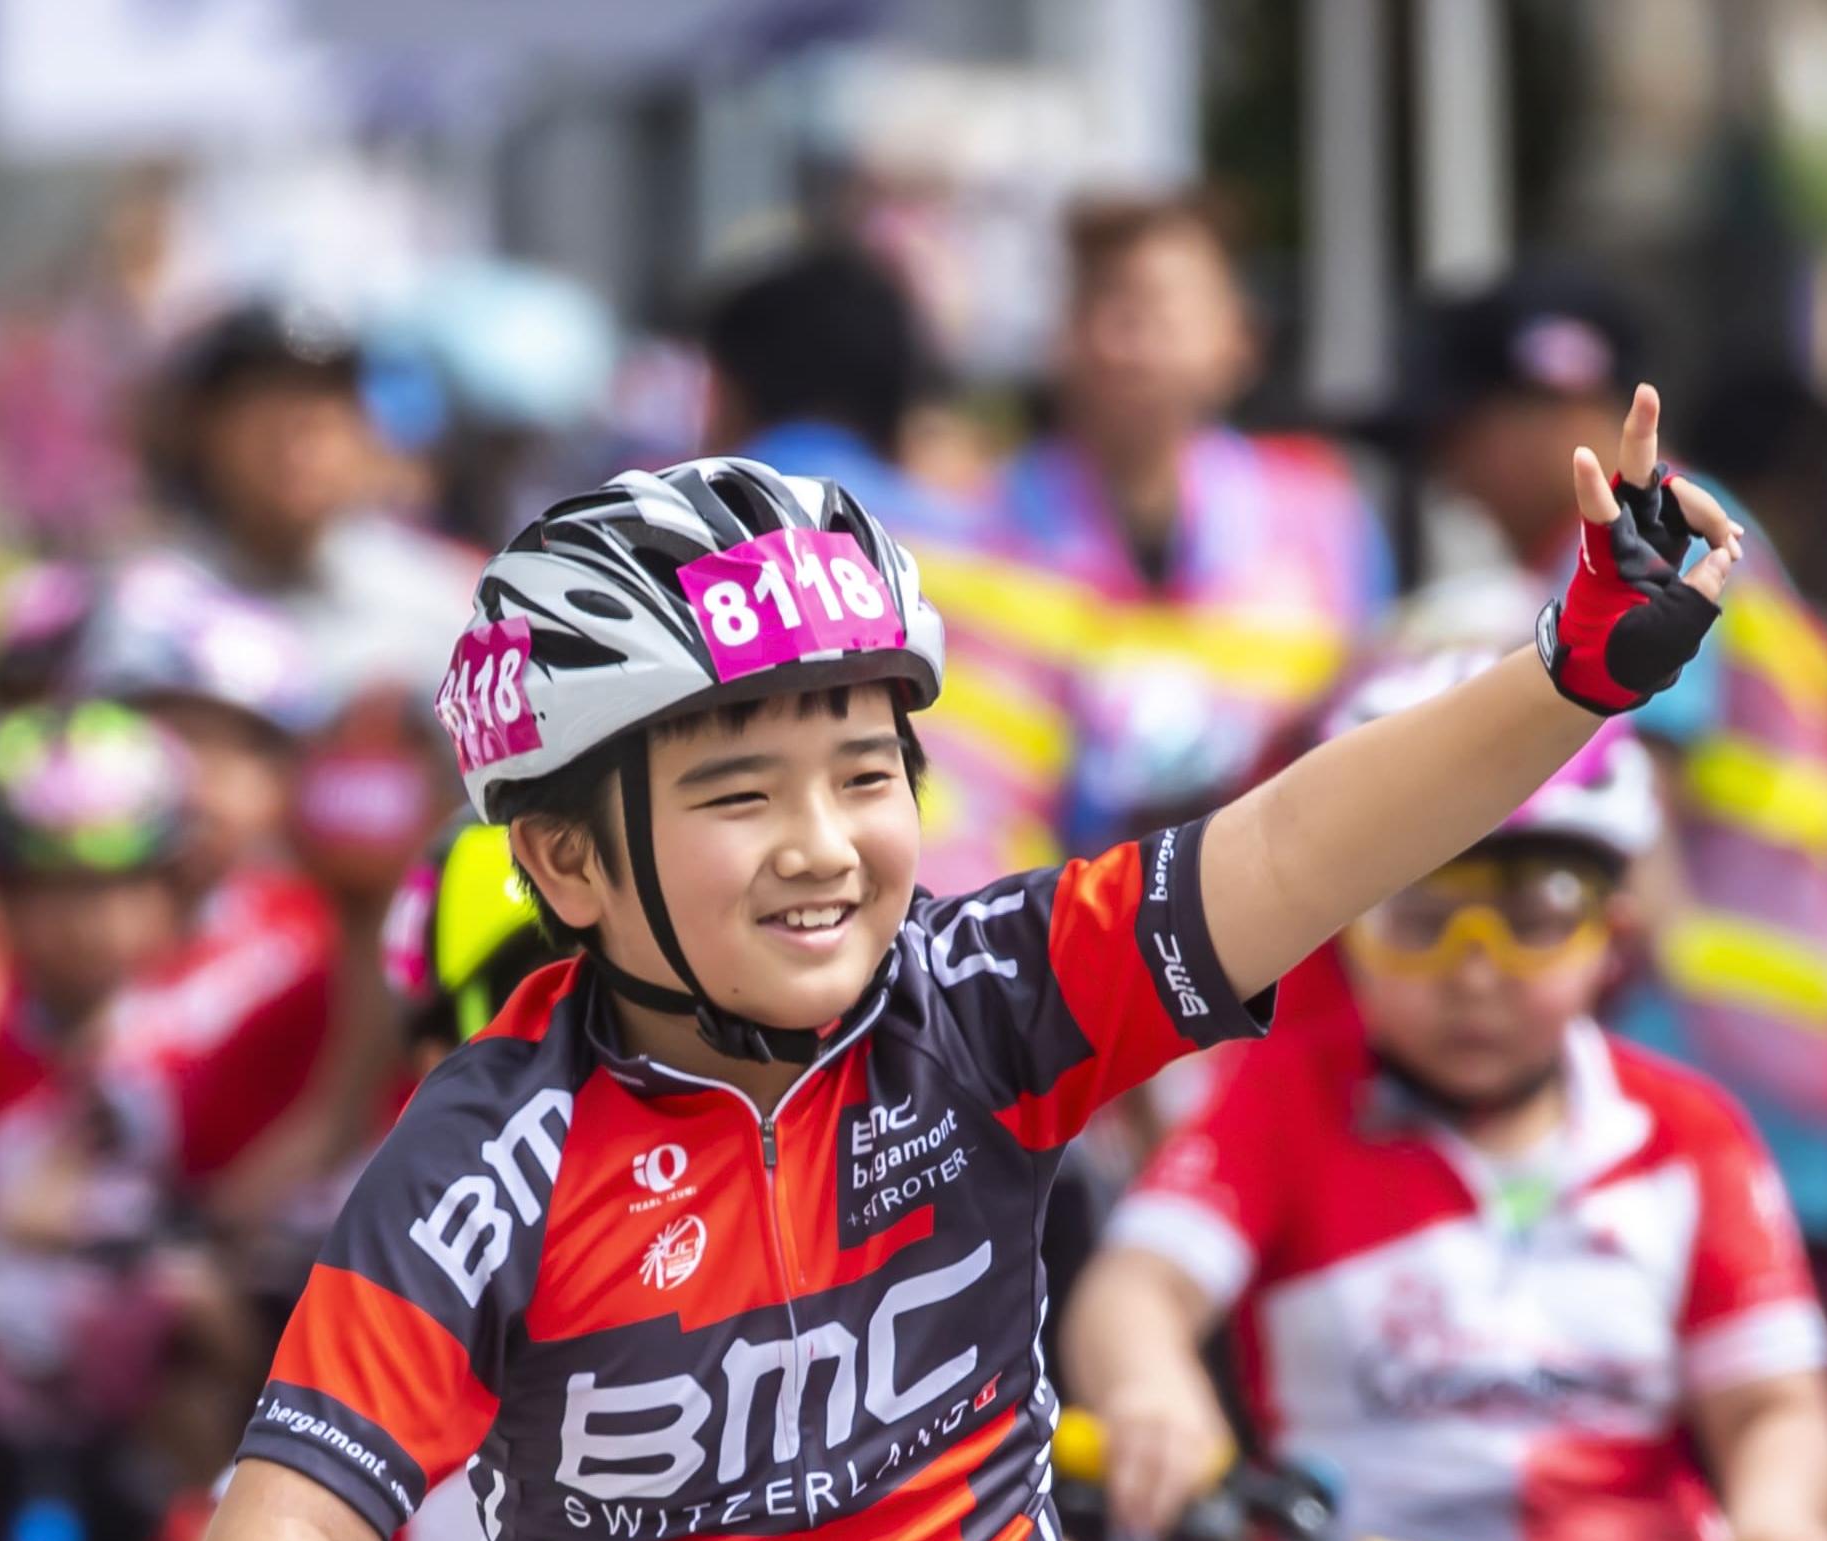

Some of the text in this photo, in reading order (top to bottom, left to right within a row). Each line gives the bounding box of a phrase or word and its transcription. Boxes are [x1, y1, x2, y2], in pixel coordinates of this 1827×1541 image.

[703, 554, 884, 647] 8118
[555, 1240, 992, 1499] BMC
[265, 1399, 387, 1477] bergamont
